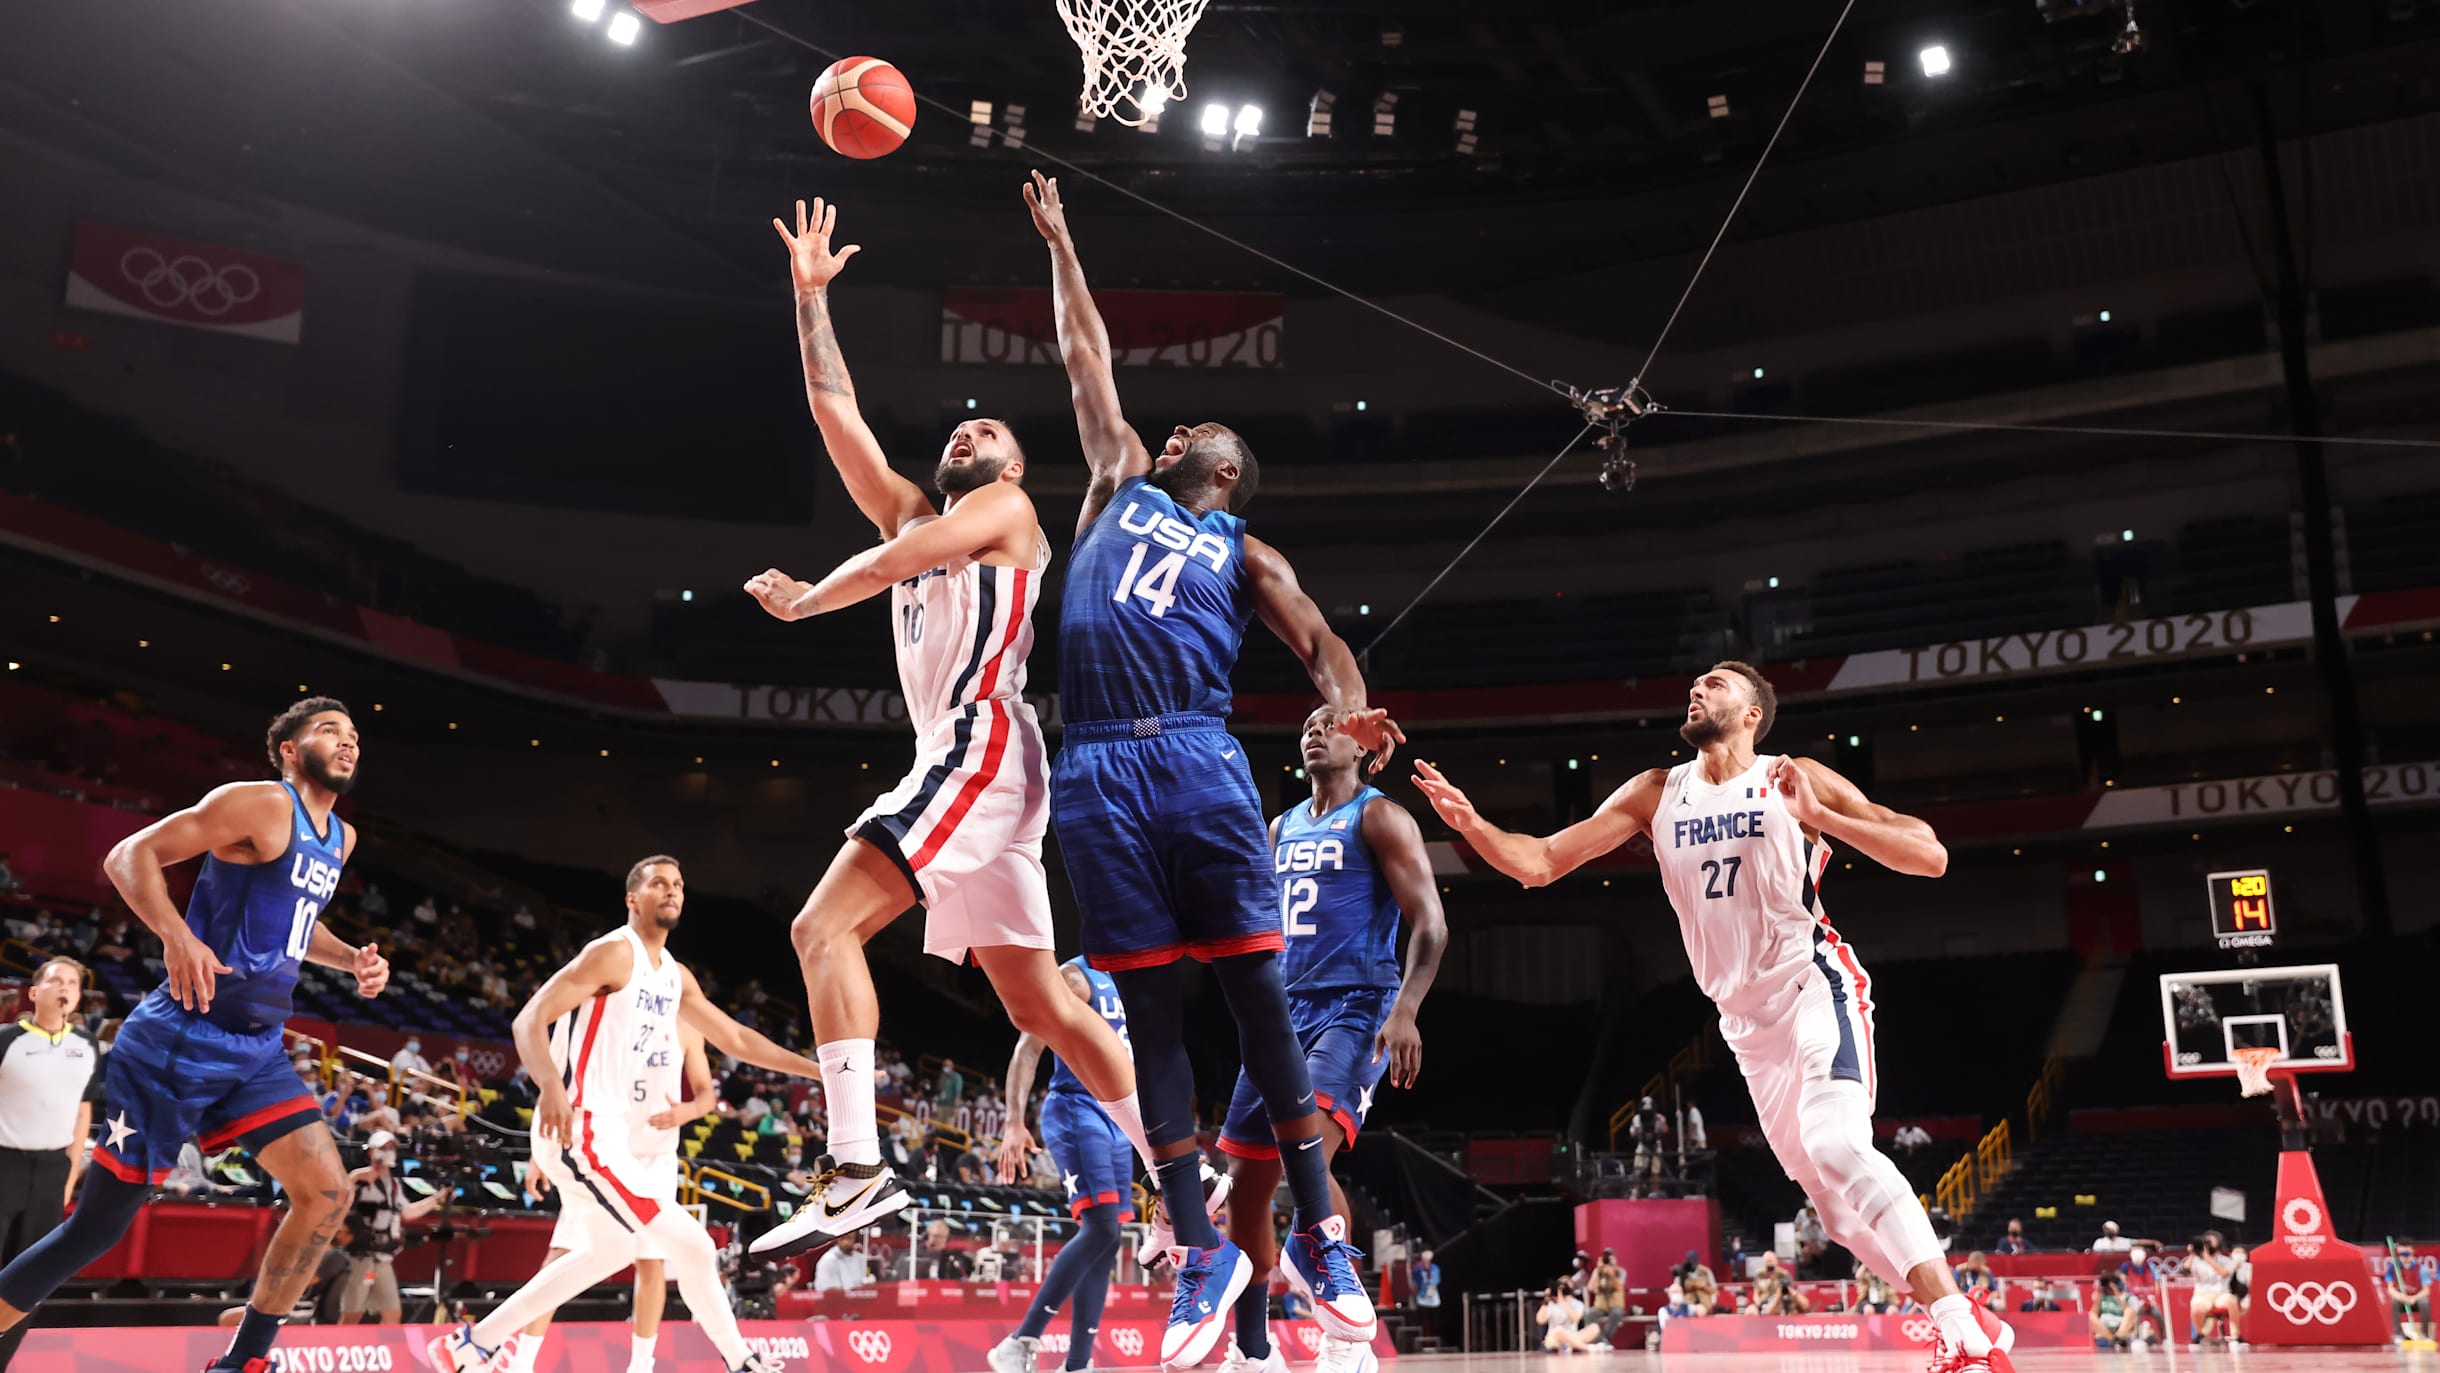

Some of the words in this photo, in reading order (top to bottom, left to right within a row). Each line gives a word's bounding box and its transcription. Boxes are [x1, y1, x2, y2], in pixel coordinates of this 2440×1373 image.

[943, 316, 1130, 366] TOKO
[1148, 320, 1281, 368] 2020
[1118, 501, 1230, 574] USA
[1113, 541, 1188, 618] 14
[903, 603, 924, 647] 10
[1900, 628, 2088, 682] TOKYO
[2107, 610, 2252, 660] 2020
[731, 683, 907, 722] TOKYO
[2162, 774, 2340, 817] TOKYO
[2363, 764, 2440, 799] 20
[1674, 811, 1765, 849] FRANCE
[290, 852, 341, 901] USA
[1275, 839, 1344, 874] USA
[1701, 856, 1742, 900] 27
[286, 896, 319, 961] 10
[1282, 877, 1319, 937] 12
[2234, 898, 2268, 930] 14
[2231, 935, 2273, 949] OMEGA
[633, 1079, 647, 1102] 5
[769, 1336, 810, 1359] 2020
[1776, 1324, 1823, 1339] TOKYO
[1823, 1324, 1858, 1339] 2020
[268, 1346, 335, 1373] OKYO
[335, 1344, 394, 1372] 2020
